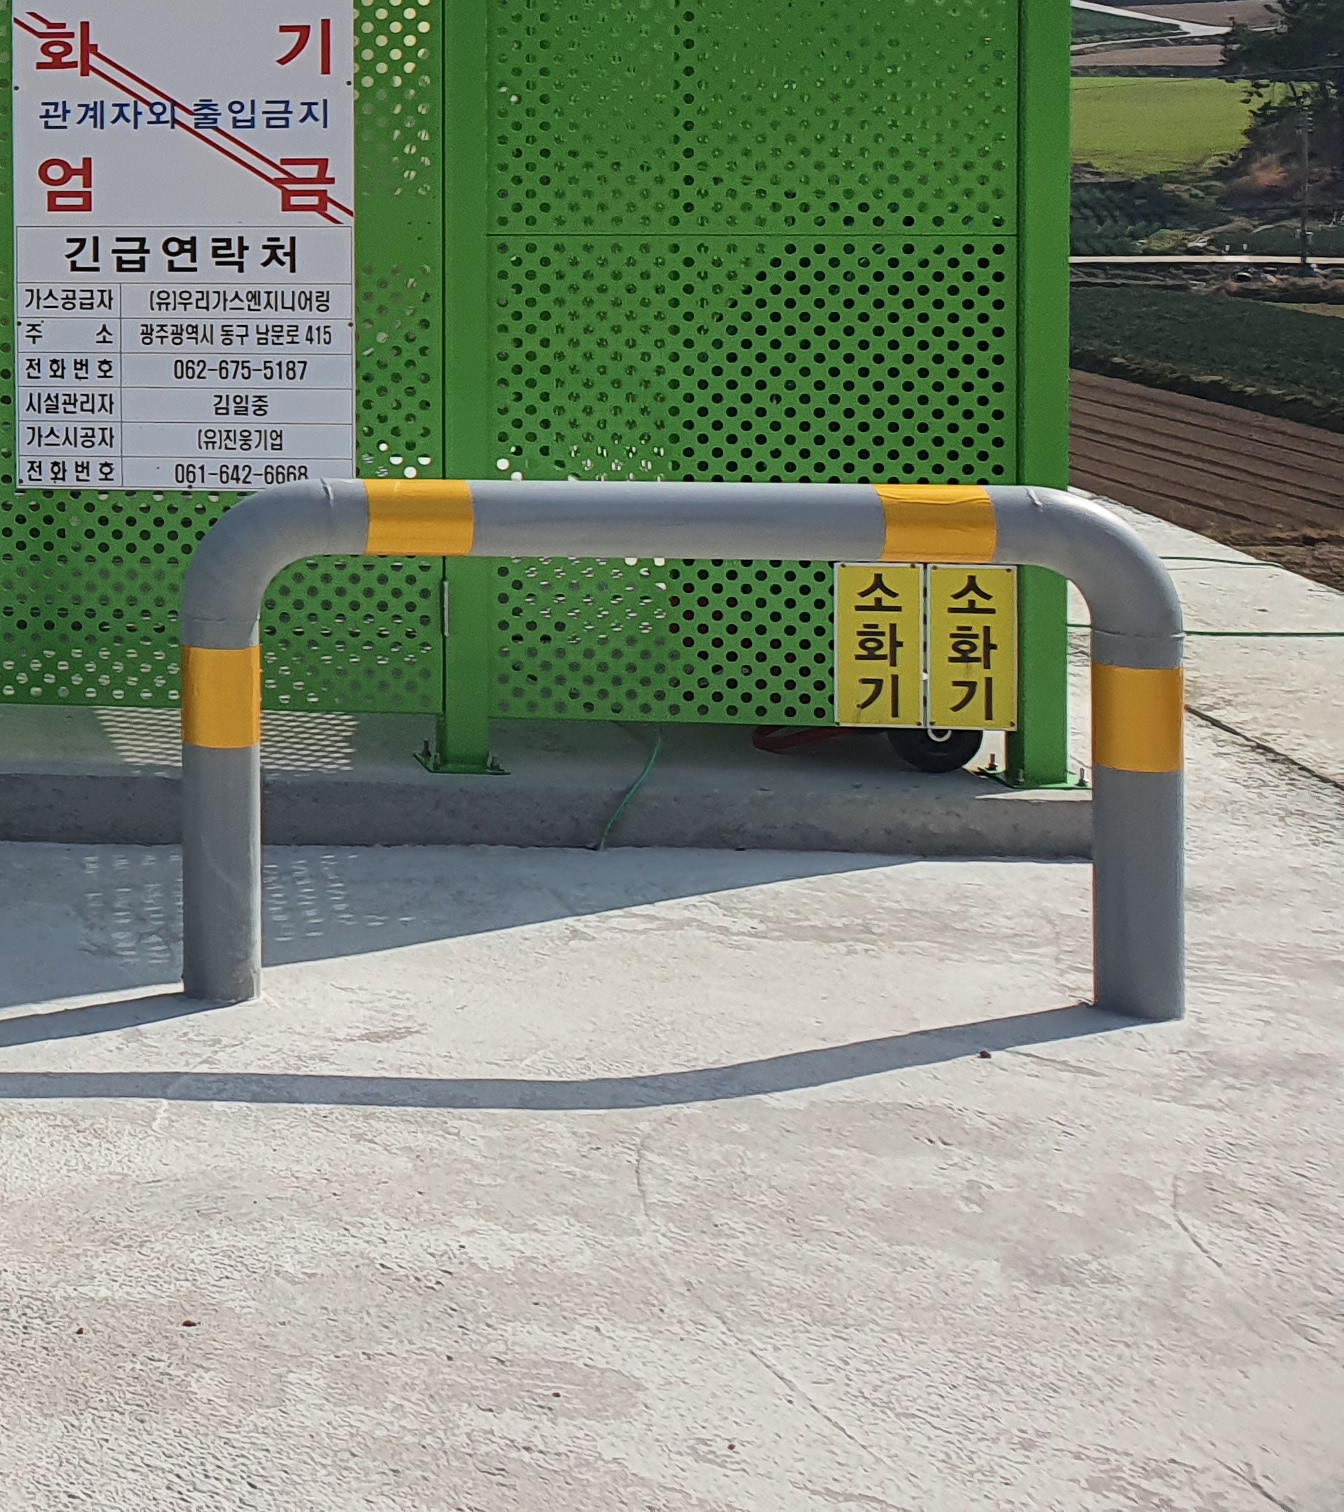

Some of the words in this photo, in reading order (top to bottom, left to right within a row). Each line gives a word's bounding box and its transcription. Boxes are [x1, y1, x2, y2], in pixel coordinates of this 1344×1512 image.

[38, 99, 177, 130] 관계자외
[191, 97, 330, 129] 출입금지
[64, 236, 298, 273] 긴급연락처
[25, 289, 113, 311] 가스공급자
[140, 324, 214, 346] 광주광역시
[221, 324, 250, 346] 동구
[256, 324, 302, 346] 남문로
[305, 324, 332, 346] 415
[173, 360, 308, 381] 062-675-5187
[25, 393, 114, 415] 시설관리자
[212, 394, 269, 417] 김일중
[26, 426, 114, 449] 가스시공자
[197, 429, 283, 452] (유)진웅기업
[174, 463, 308, 486] 061-642-6668
[854, 573, 903, 718] 소화기
[947, 575, 997, 721] 소화기
